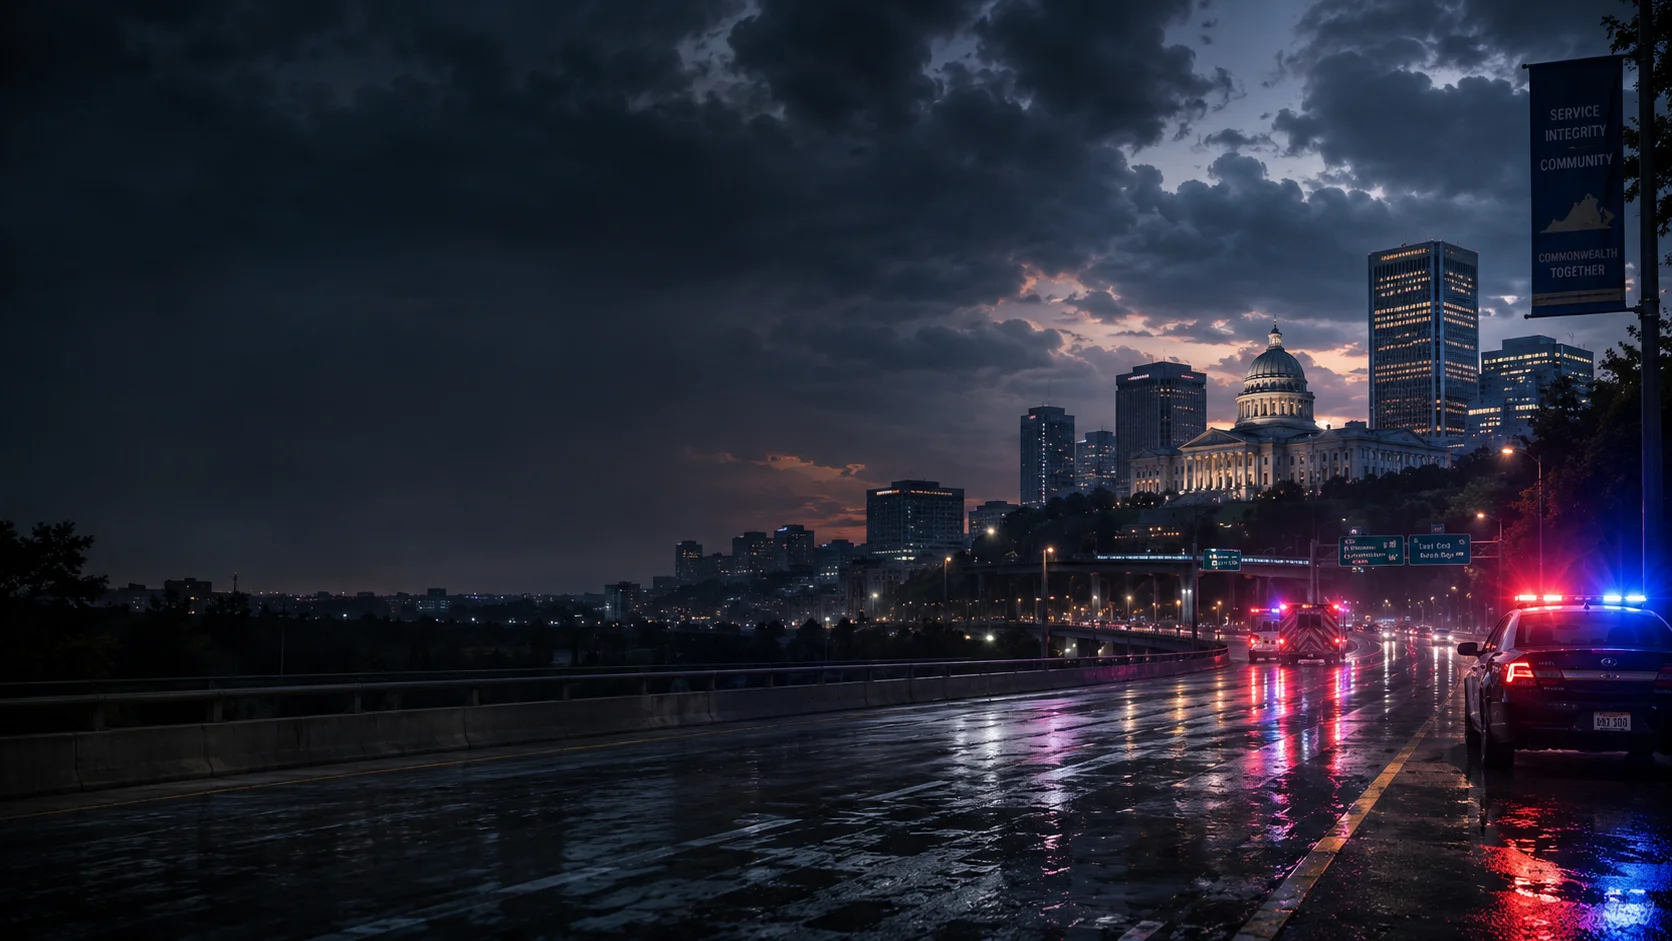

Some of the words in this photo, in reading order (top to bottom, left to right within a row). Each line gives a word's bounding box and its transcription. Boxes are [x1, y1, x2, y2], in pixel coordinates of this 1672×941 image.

[1550, 104, 1600, 121] SERVICE
[1545, 123, 1607, 142] INTEGRITY
[1540, 152, 1613, 171] COMMUNITY
[1538, 248, 1618, 263] COMMONWEALTH
[1550, 264, 1605, 279] TOGETHER
